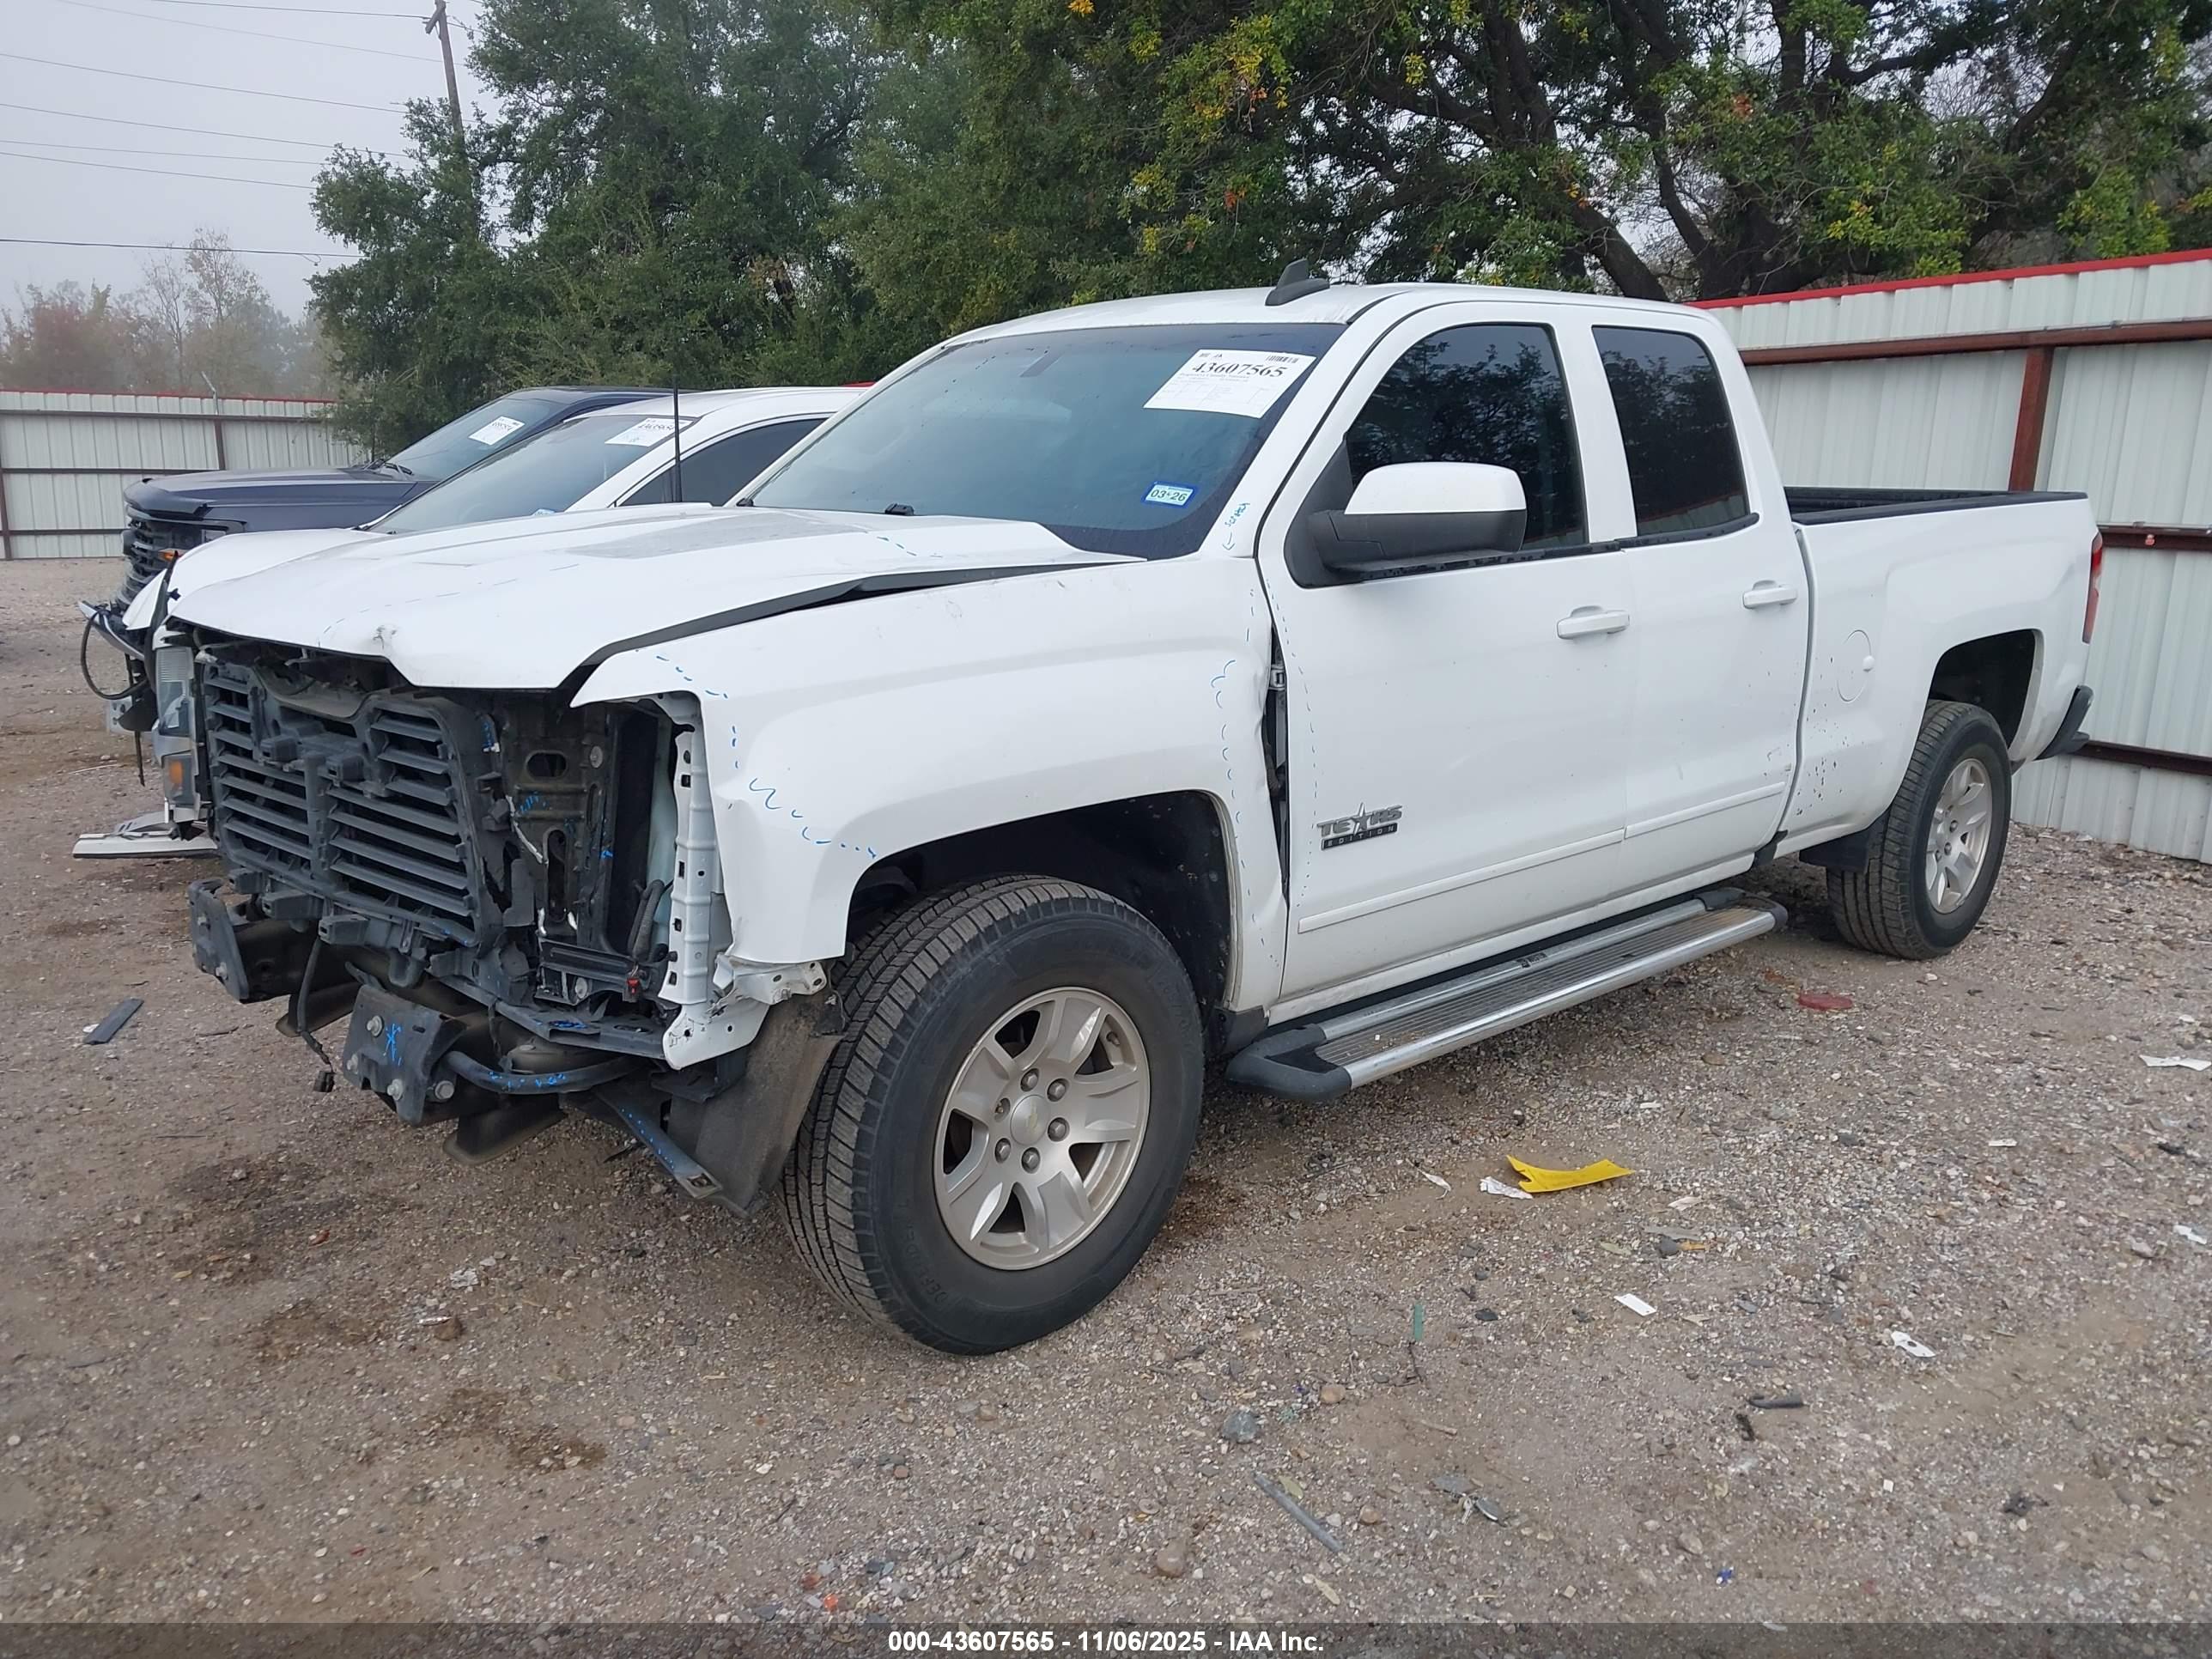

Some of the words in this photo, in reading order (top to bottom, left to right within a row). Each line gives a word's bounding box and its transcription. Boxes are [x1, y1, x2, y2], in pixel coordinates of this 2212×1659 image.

[1192, 362, 1288, 378] 43607565
[1151, 489, 1167, 499] 03
[1170, 492, 1188, 501] 26
[1316, 802, 1402, 838] TEXAS
[1327, 825, 1395, 847] EDITION
